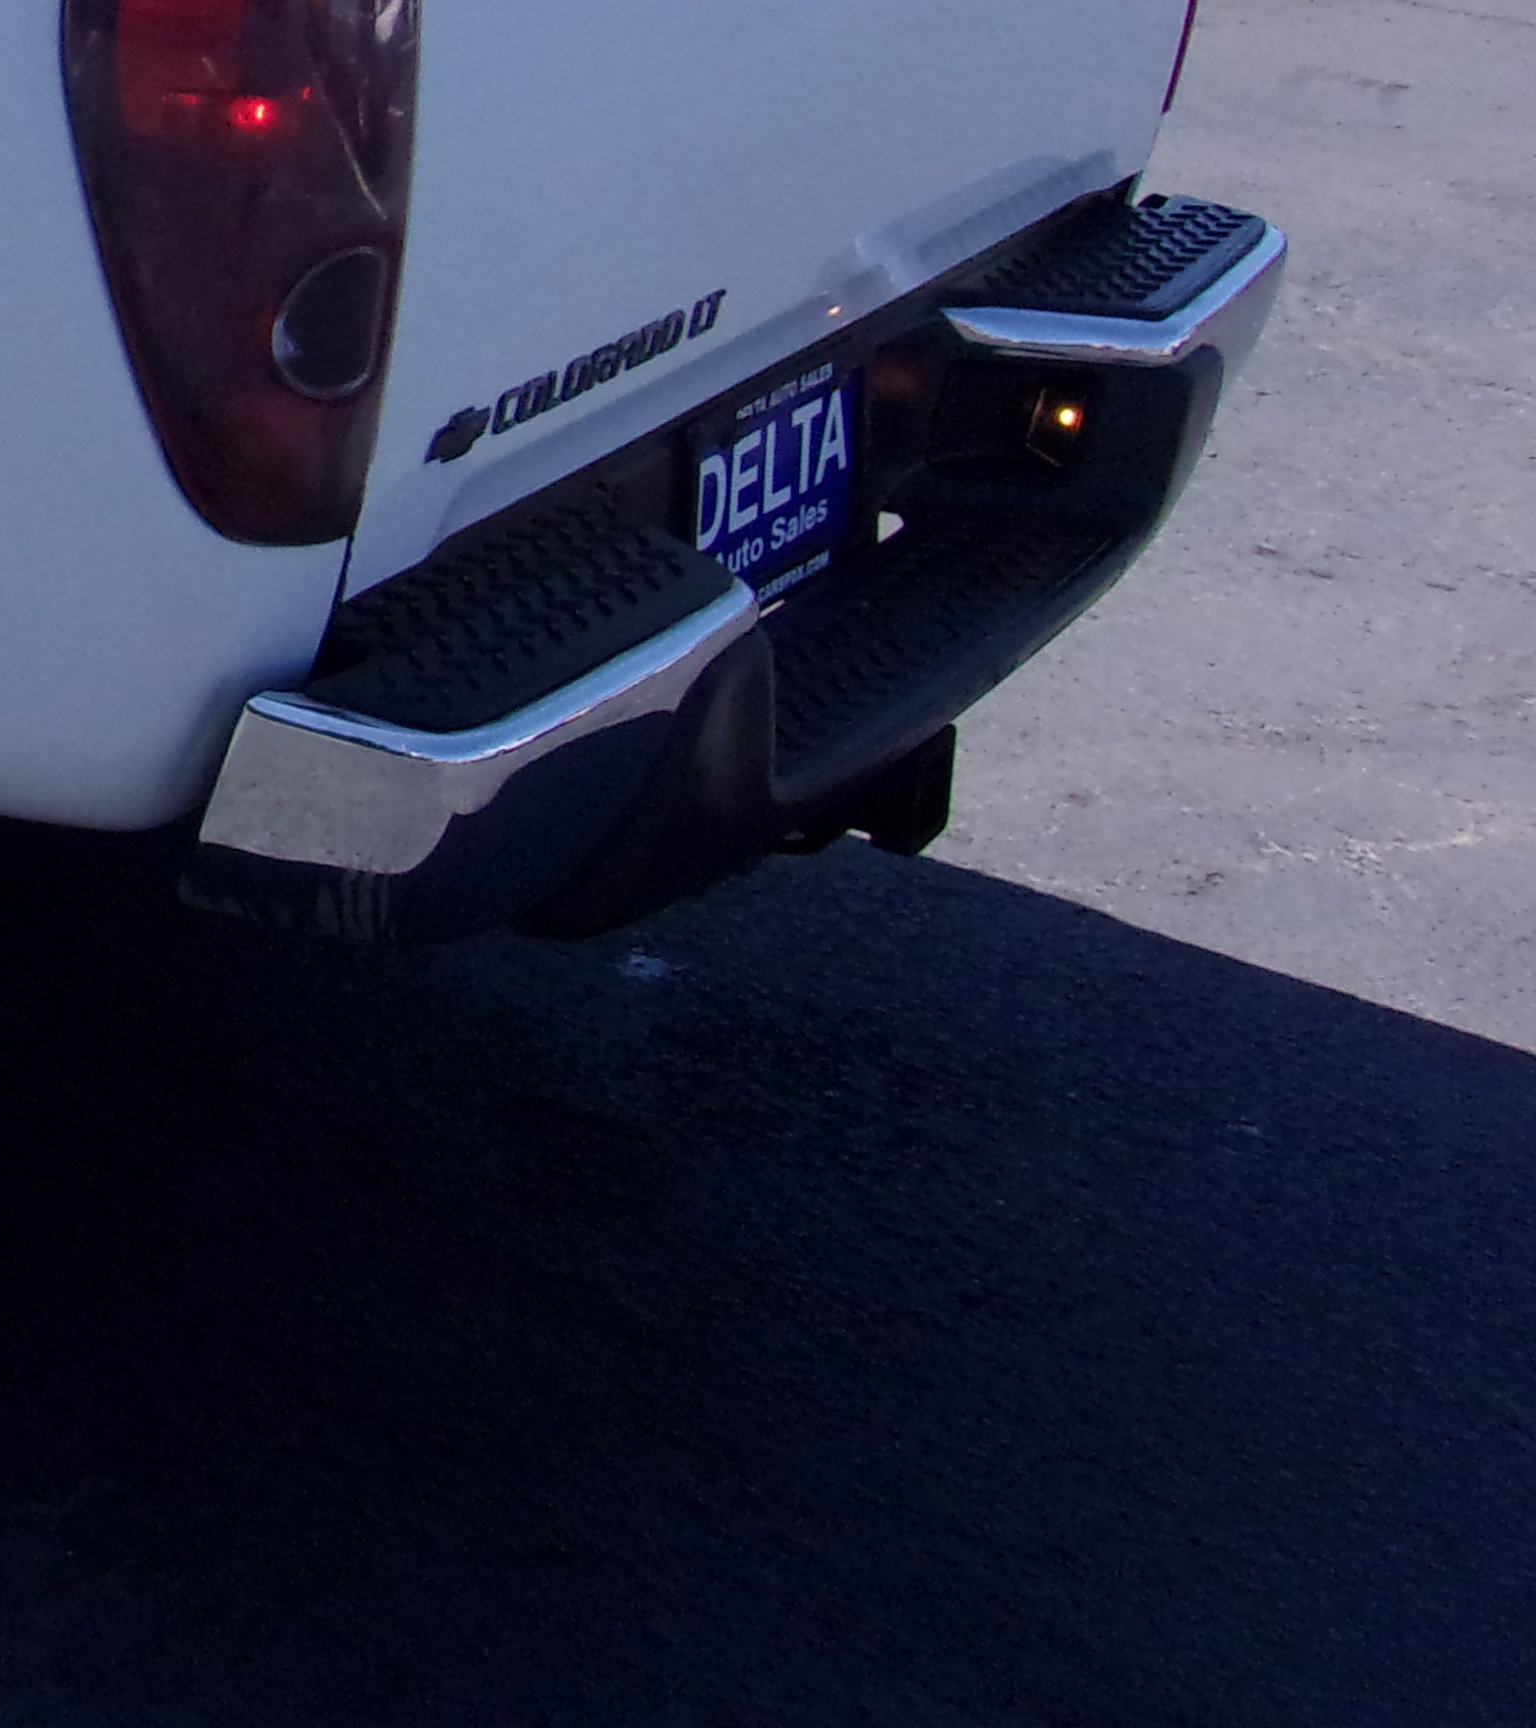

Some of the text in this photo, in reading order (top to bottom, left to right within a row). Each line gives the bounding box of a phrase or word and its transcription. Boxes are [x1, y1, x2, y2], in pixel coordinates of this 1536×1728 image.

[491, 289, 726, 435] COLORADO LT
[696, 388, 847, 552] DELTA
[770, 498, 829, 551] Sales
